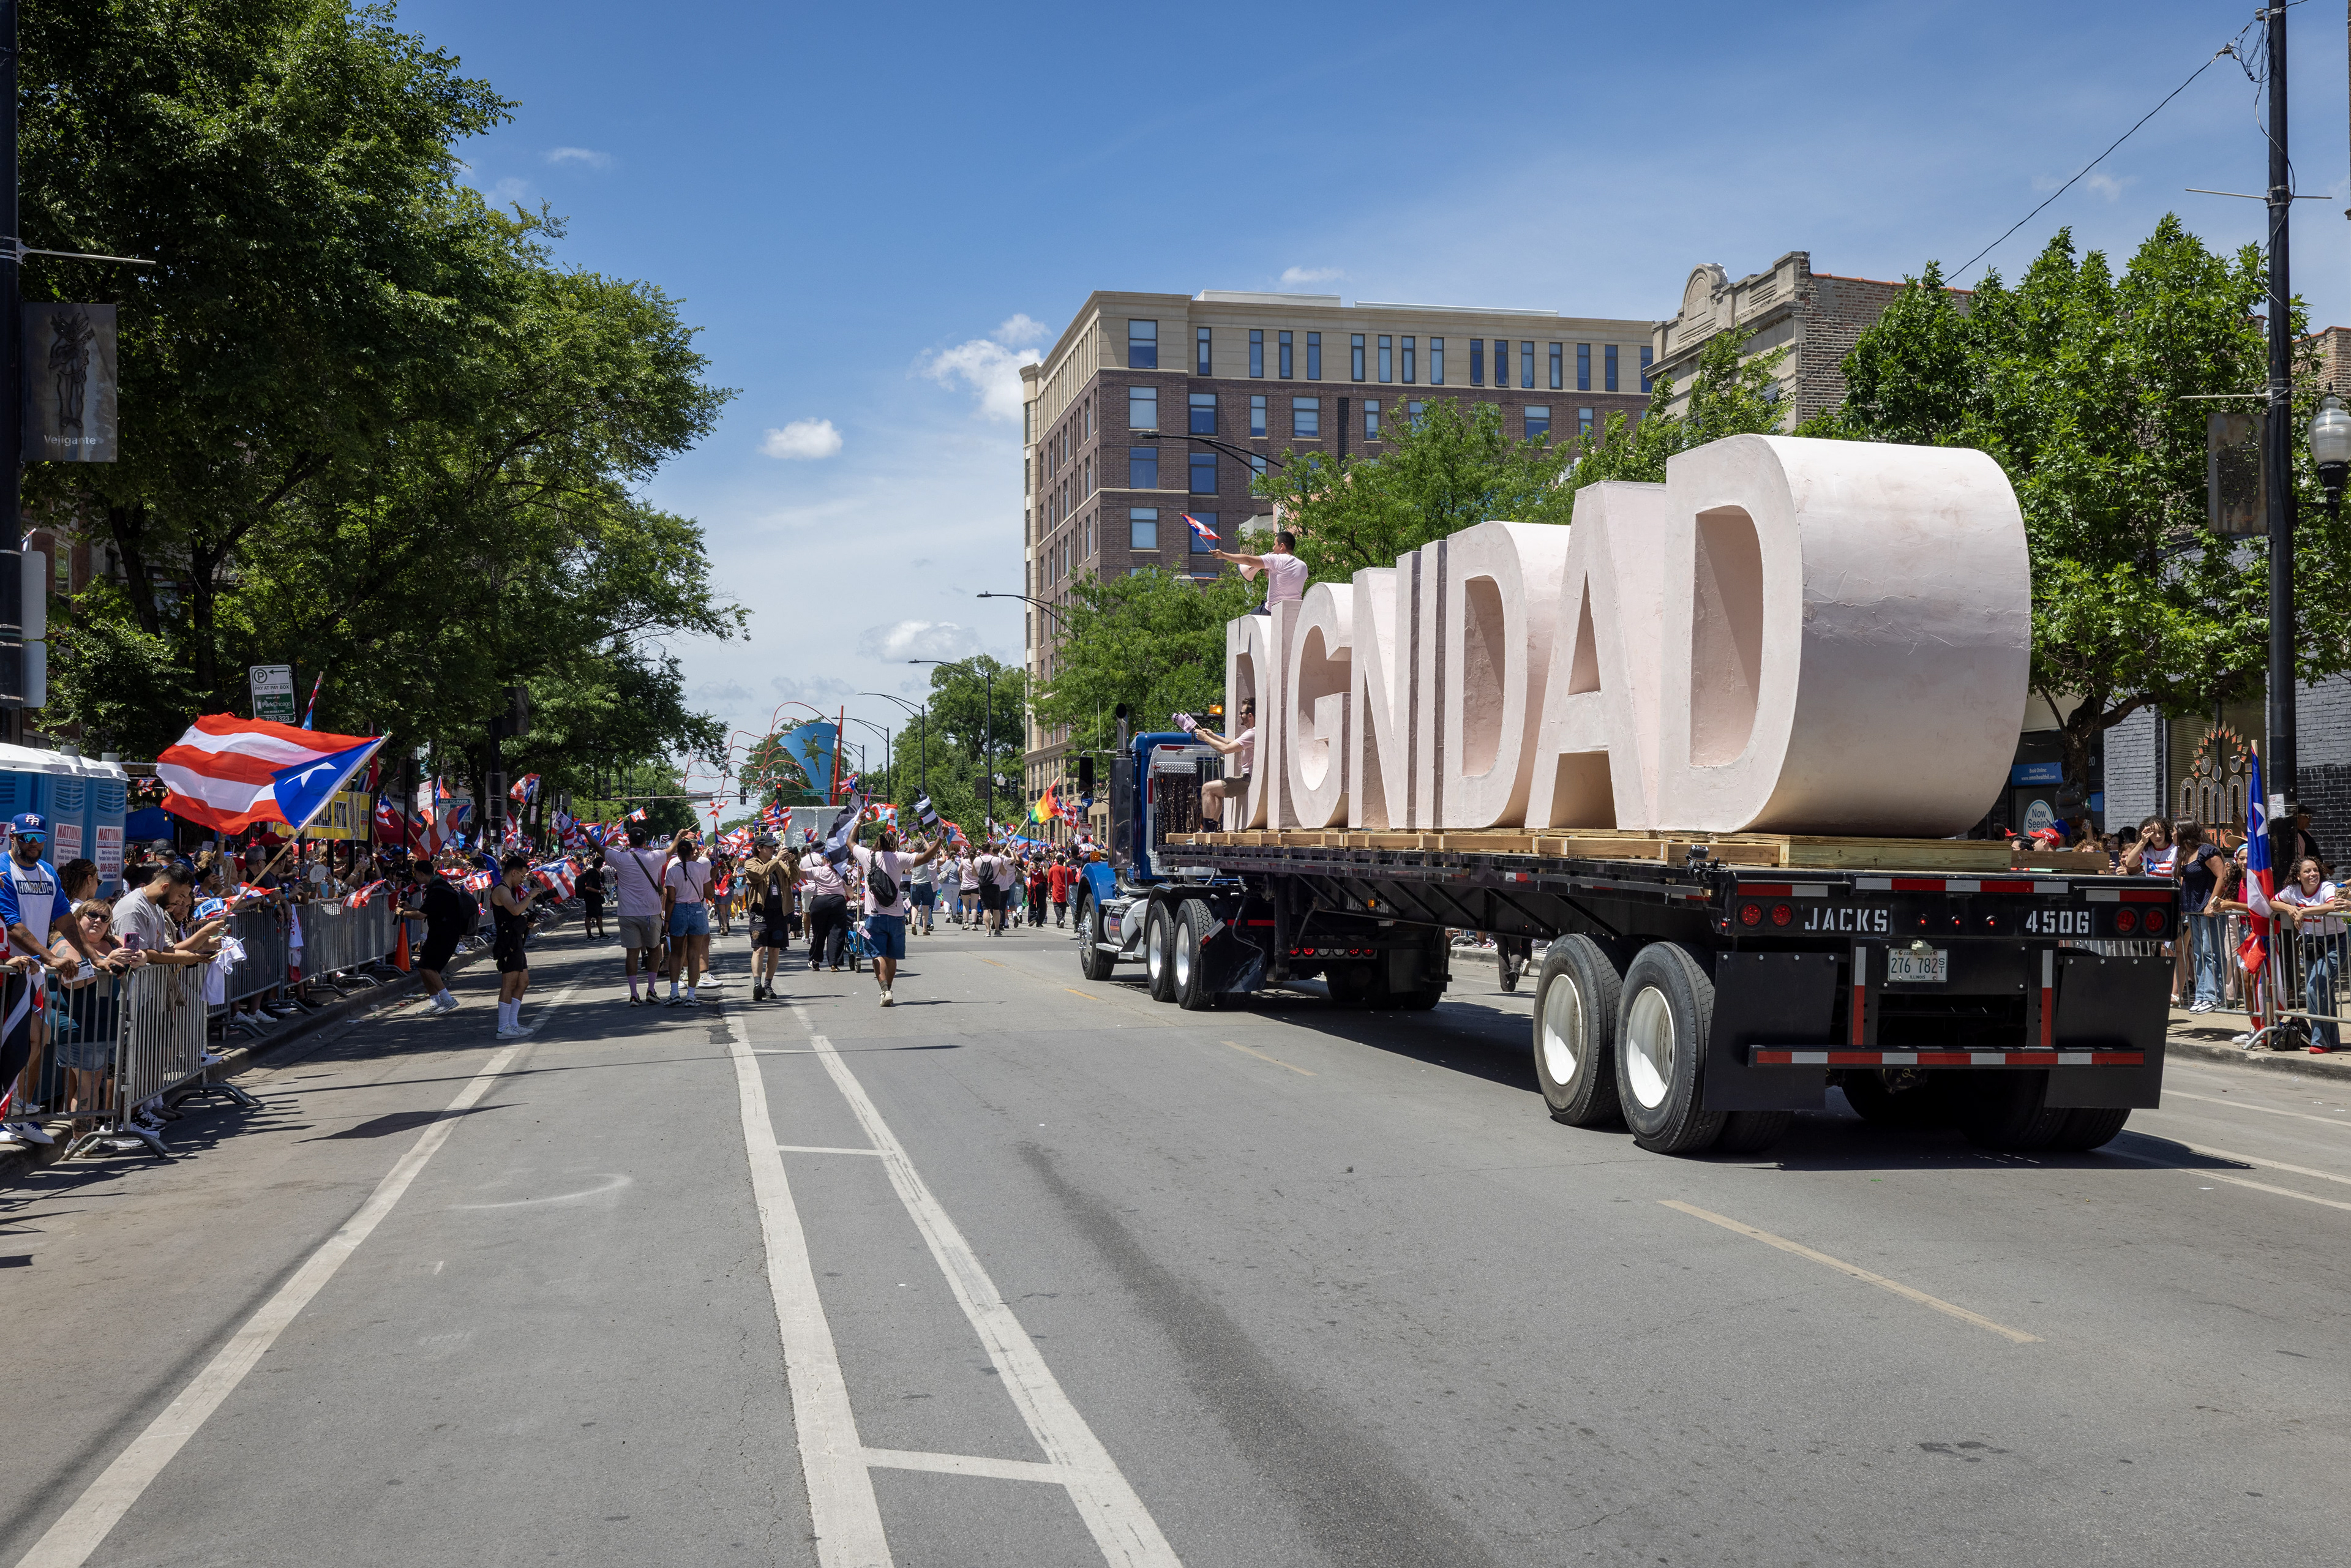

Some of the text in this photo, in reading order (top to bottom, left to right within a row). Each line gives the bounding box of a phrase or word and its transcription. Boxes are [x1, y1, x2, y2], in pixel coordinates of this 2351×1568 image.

[44, 435, 96, 446] Vejigante
[1225, 433, 2030, 836] DIGNIDAD
[2031, 809, 2046, 818] Now
[2028, 819, 2050, 828] Seeing
[57, 825, 81, 841] NATIONAL
[98, 828, 122, 841] NATIONAL
[18, 882, 49, 894] HUMBOLDT
[1805, 907, 1888, 932] JACKS
[2025, 910, 2089, 934] 4506
[1891, 958, 1911, 973] 276
[1918, 958, 1938, 973] 782
